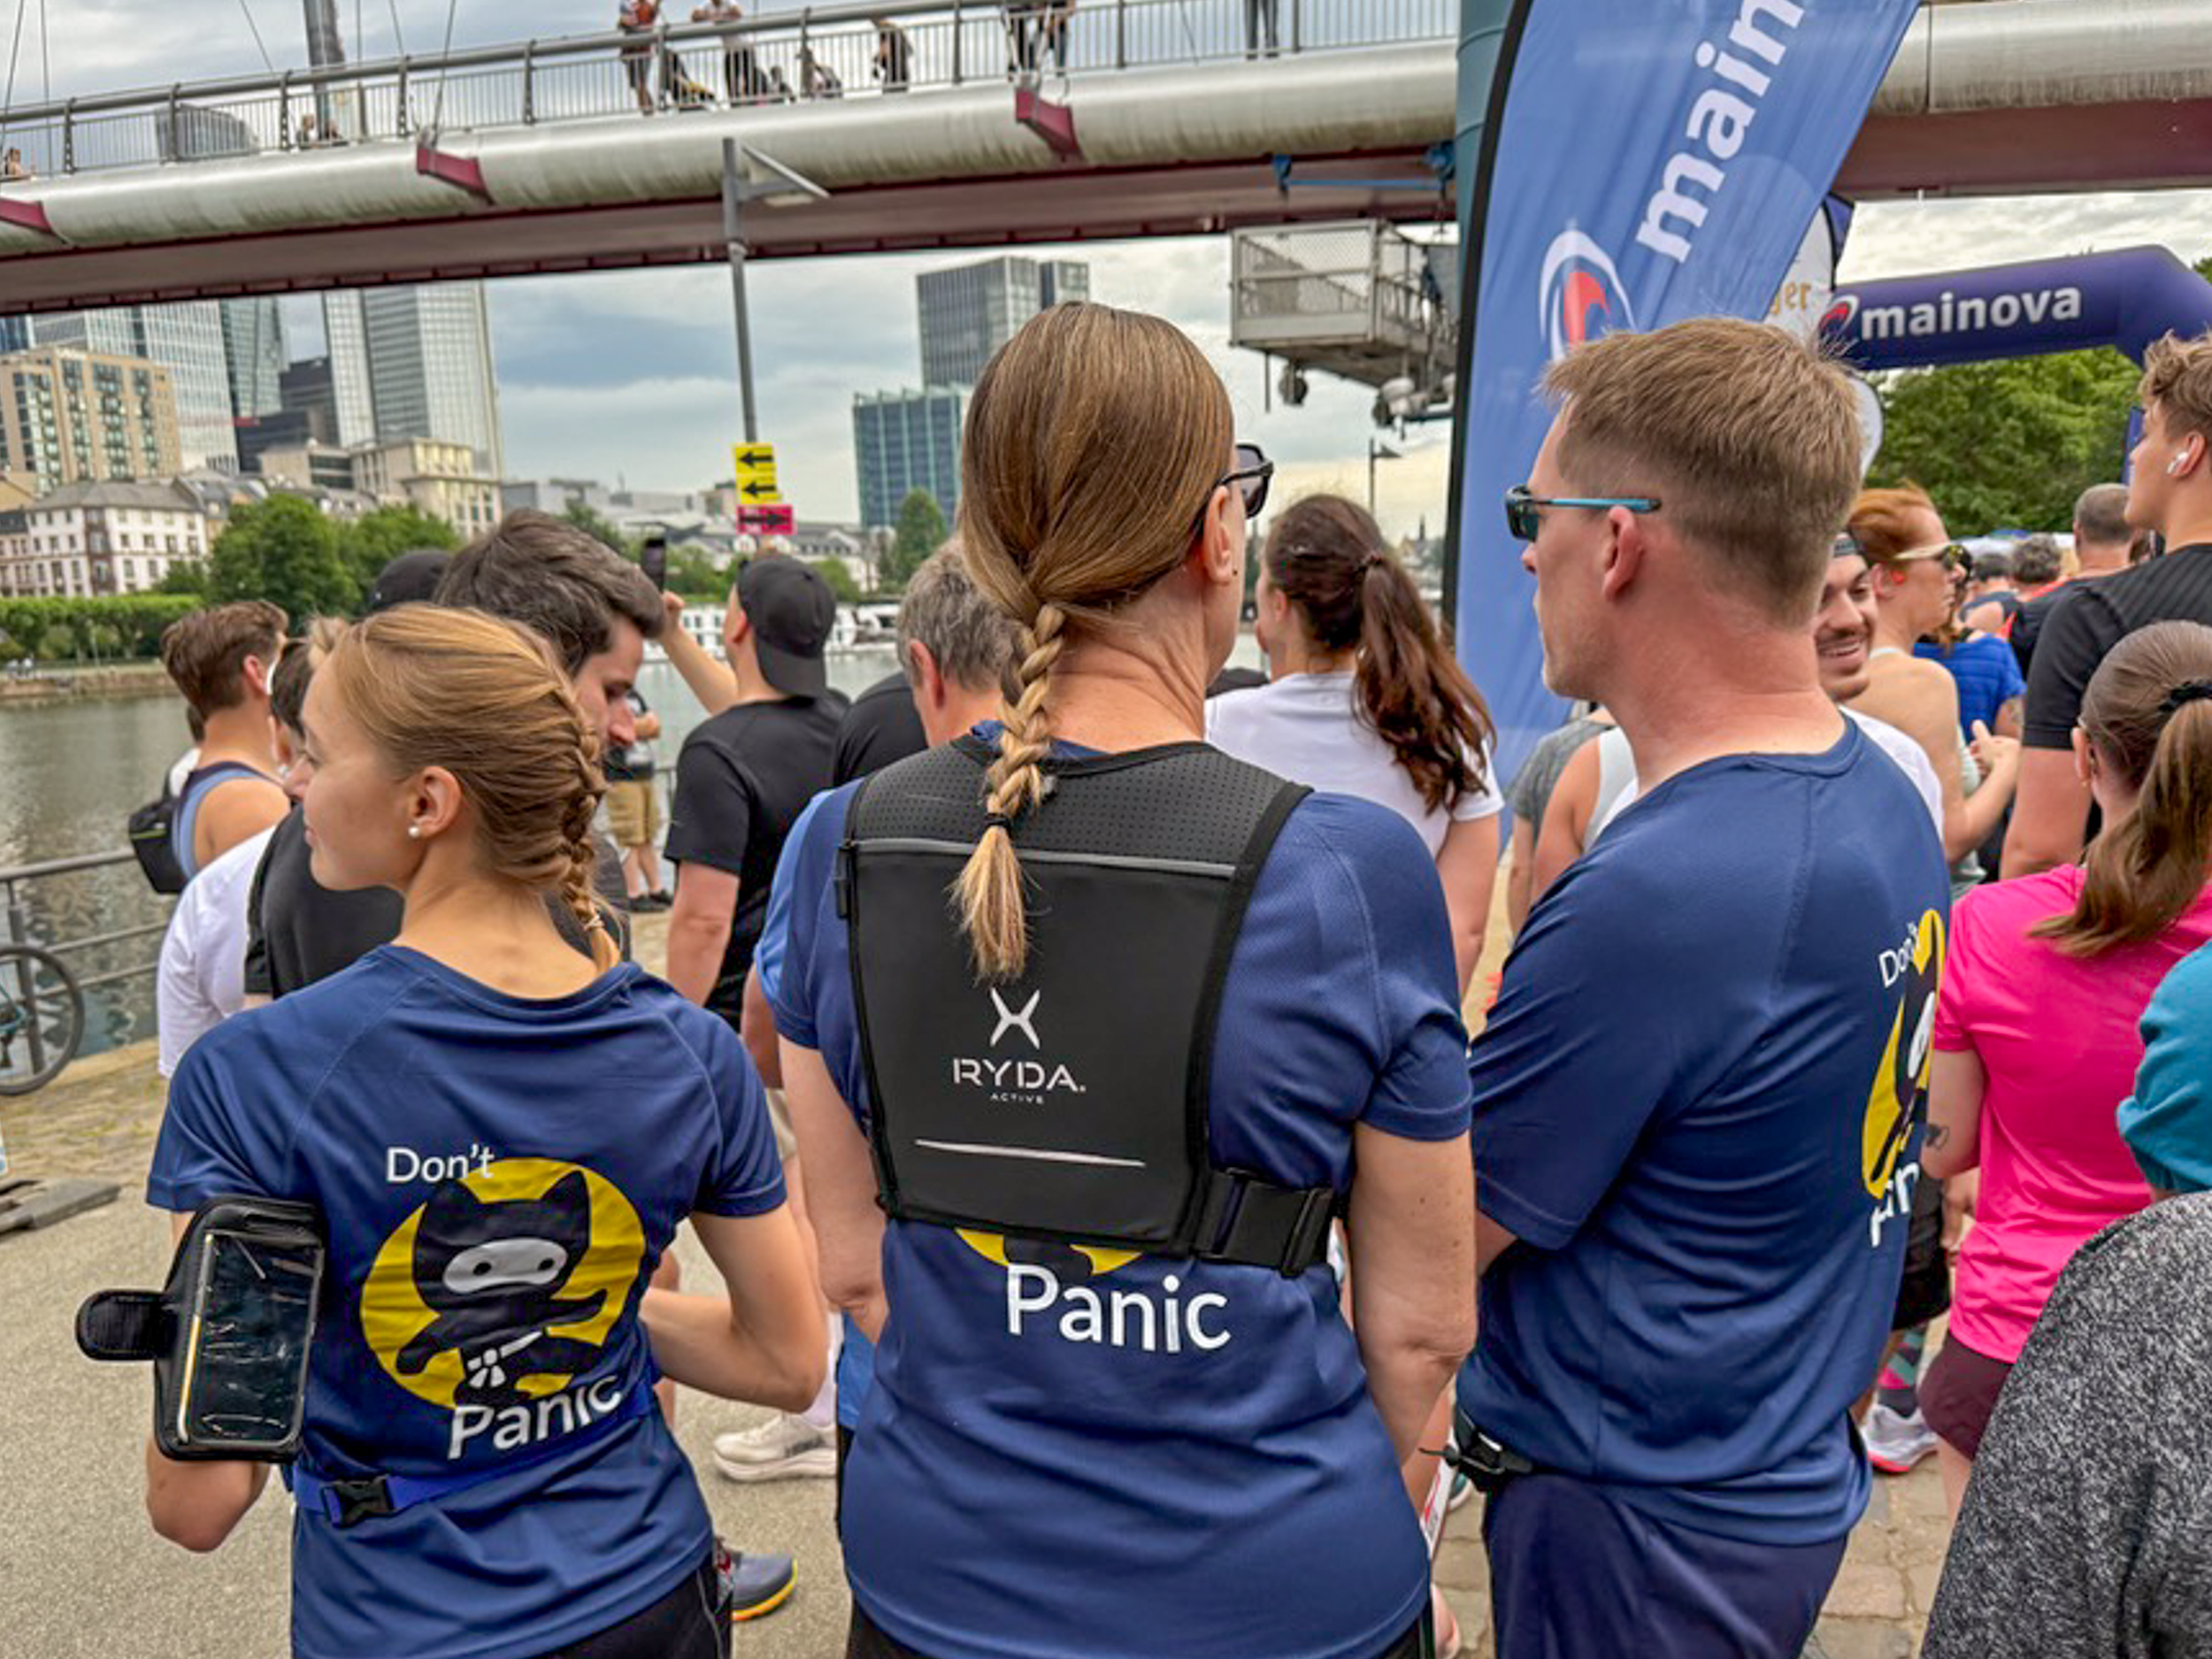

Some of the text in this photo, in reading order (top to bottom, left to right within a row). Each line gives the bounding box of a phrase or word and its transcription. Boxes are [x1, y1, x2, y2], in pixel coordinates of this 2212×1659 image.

[1861, 287, 2081, 341] mainova
[989, 1092, 1044, 1105] ACTIVE
[387, 1143, 495, 1183] Don't
[1006, 1262, 1232, 1354] Panic
[447, 1374, 622, 1460] Panic
